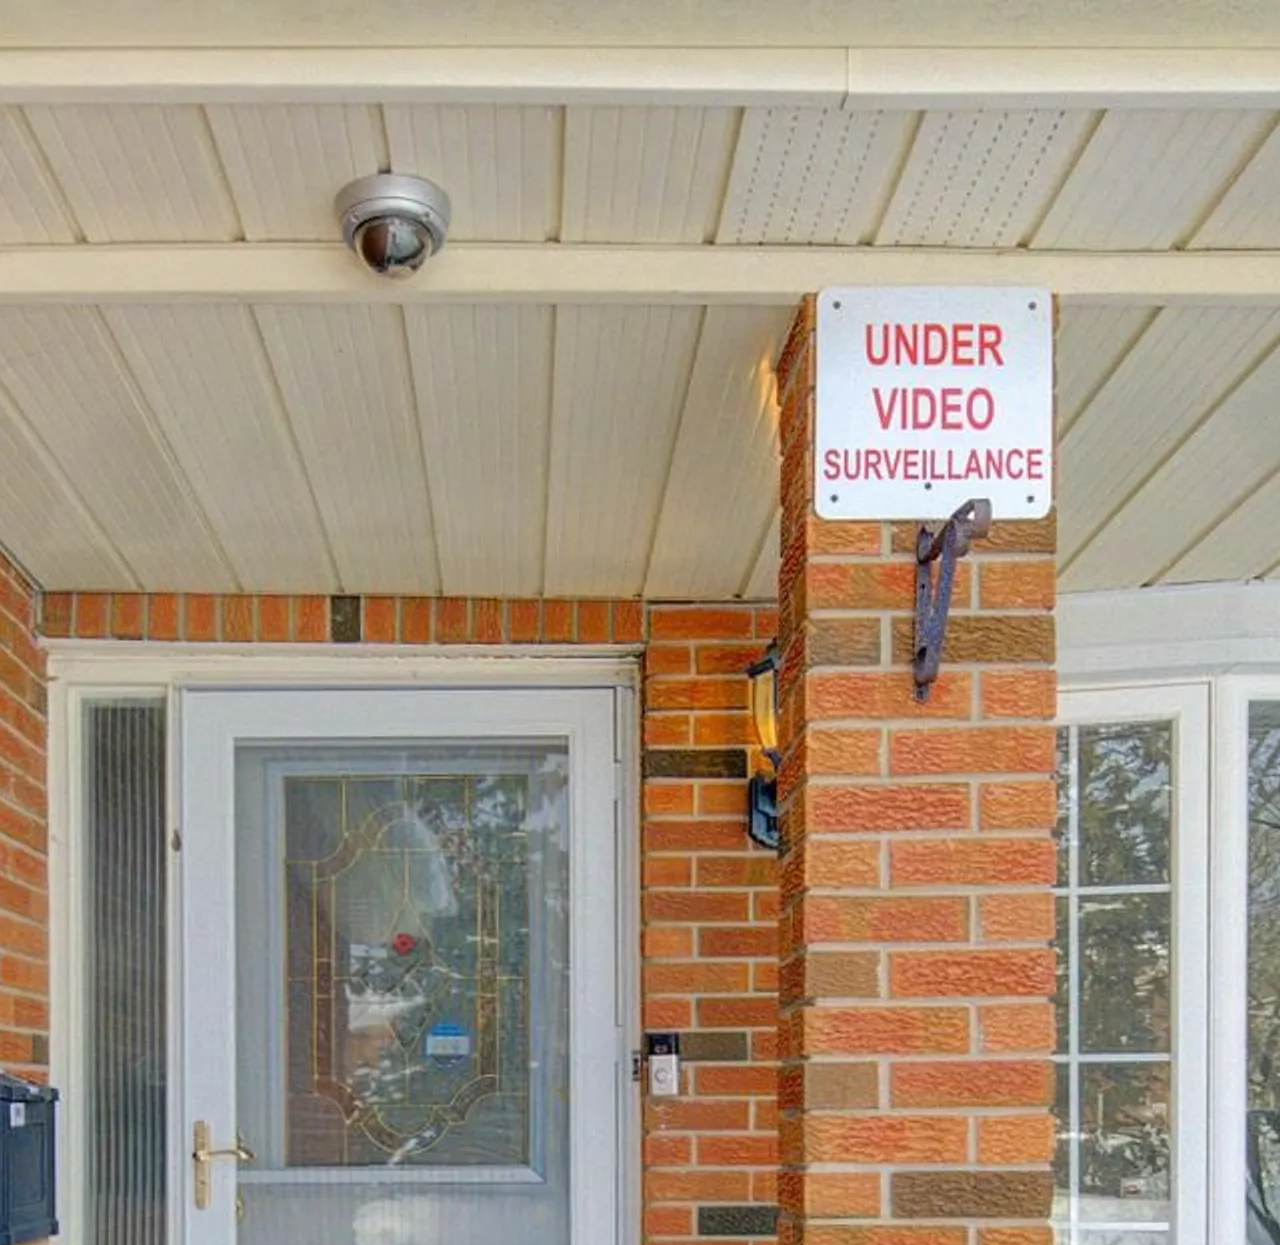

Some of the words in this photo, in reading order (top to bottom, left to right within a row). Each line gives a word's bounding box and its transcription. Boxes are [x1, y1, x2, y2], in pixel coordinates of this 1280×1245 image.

[865, 323, 1004, 366] UNDER
[872, 387, 995, 430] VIDEO
[823, 449, 1043, 480] SURVEILLANCE
